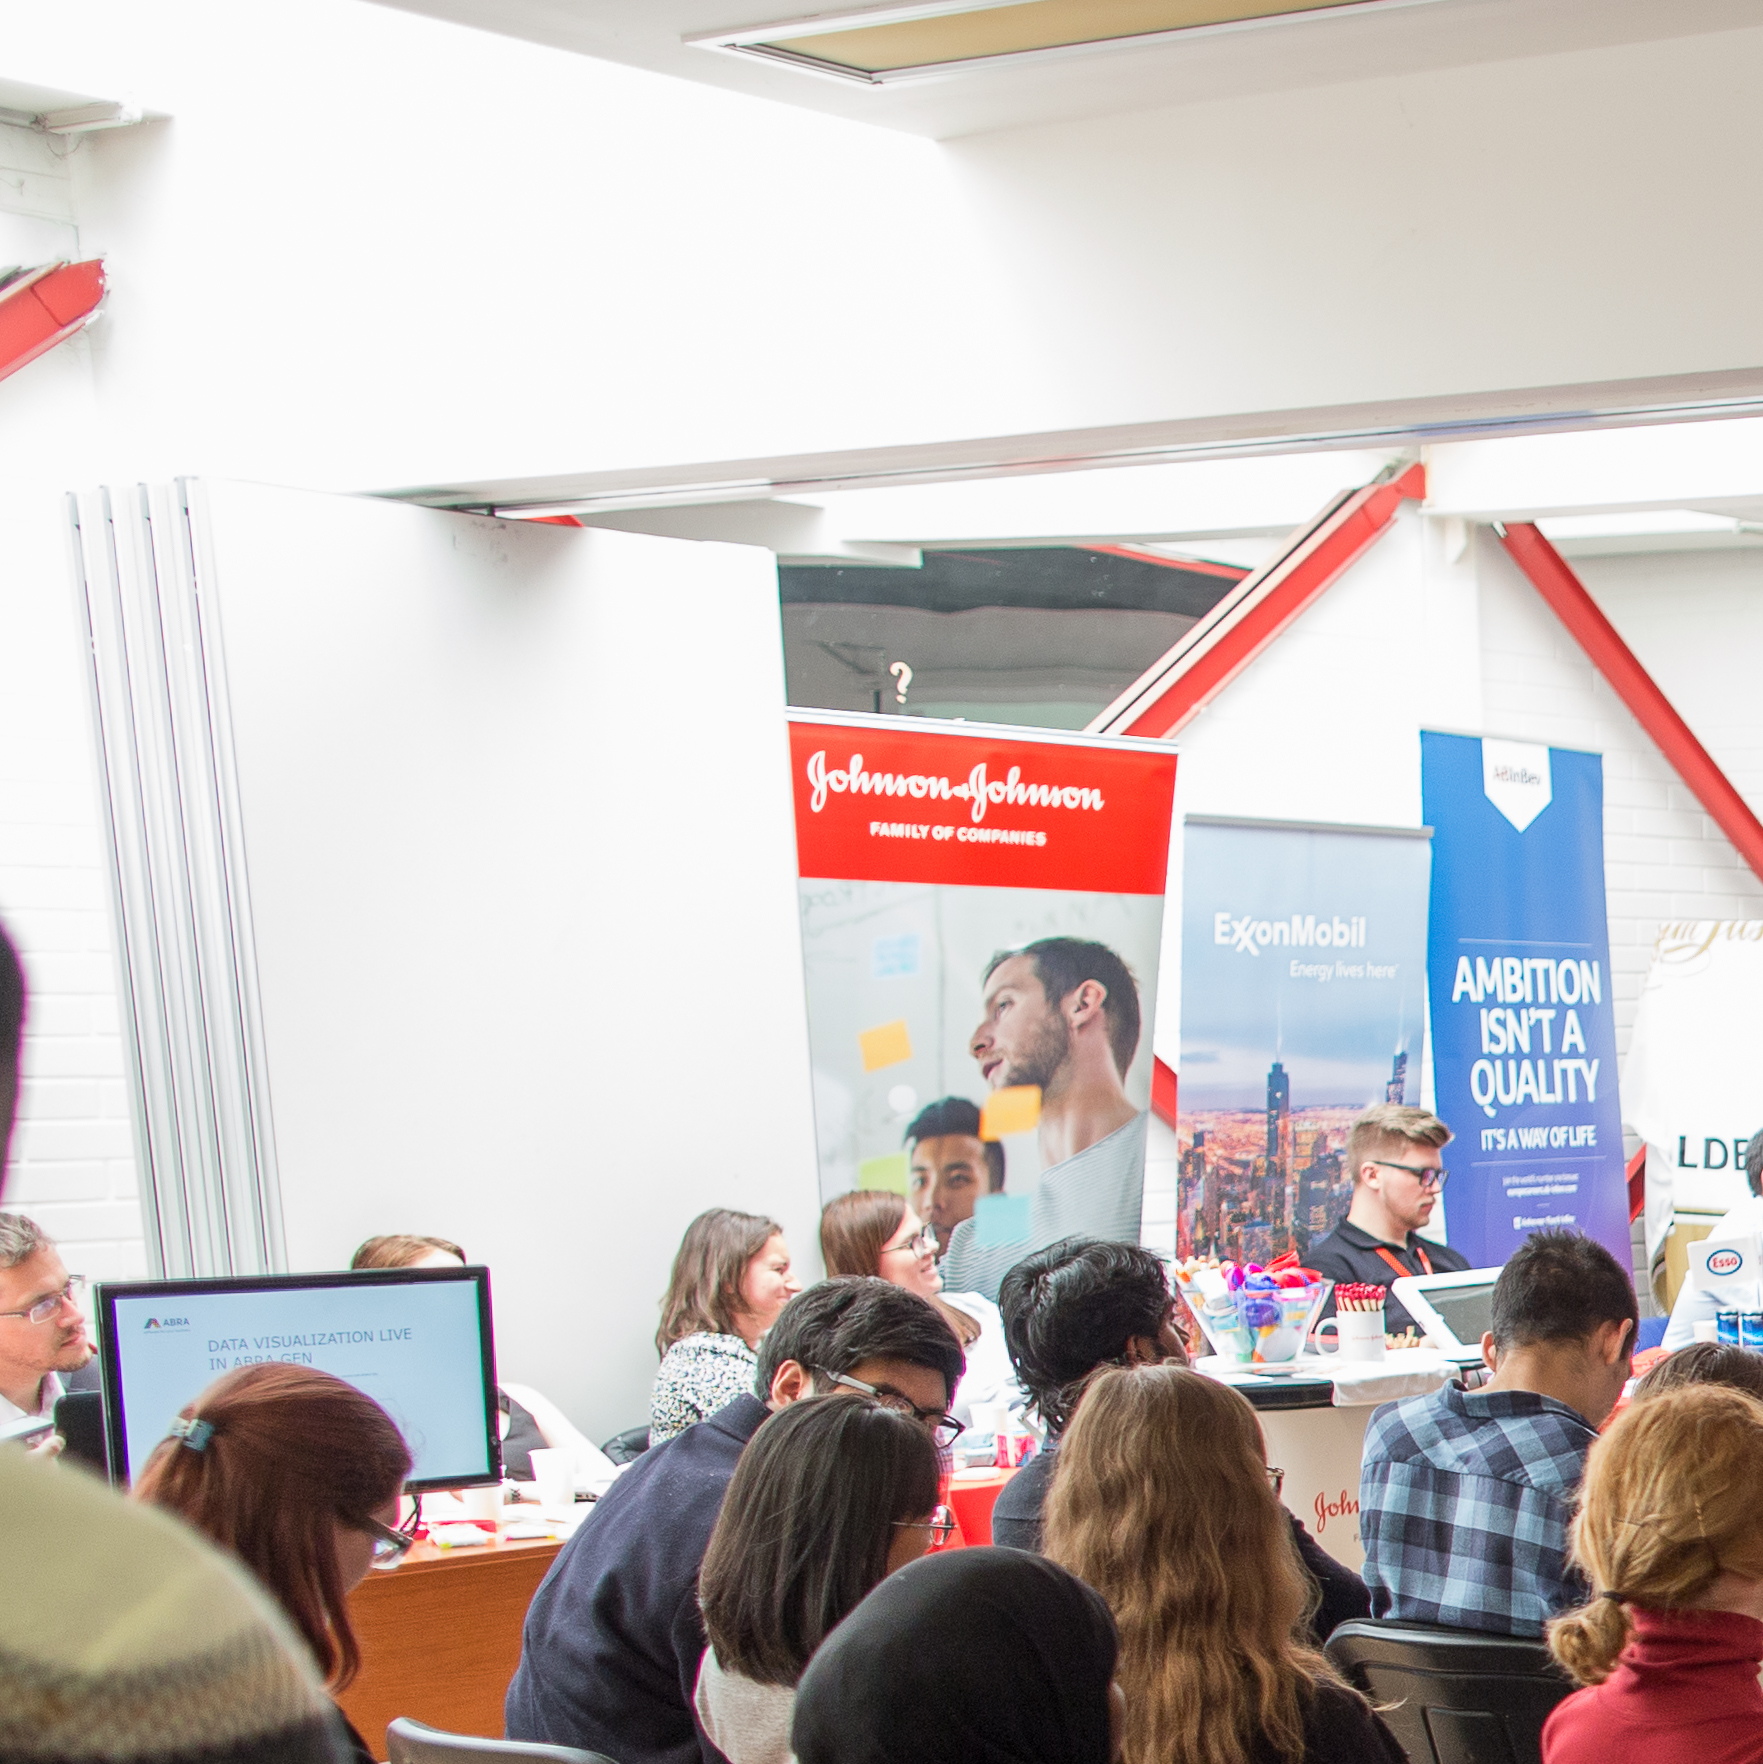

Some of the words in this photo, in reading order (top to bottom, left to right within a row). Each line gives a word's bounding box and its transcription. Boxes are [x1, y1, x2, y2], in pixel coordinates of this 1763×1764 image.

[869, 821, 929, 840] FAMILY
[931, 825, 954, 841] OF
[956, 826, 1047, 847] COMPANIES
[1214, 912, 1366, 957] ExxonMobil
[1289, 959, 1333, 982] Energy
[1335, 960, 1365, 978] lives
[1452, 955, 1602, 1006] AMBITION
[1480, 1007, 1557, 1055] ISN'T
[1561, 1009, 1587, 1054] A
[1470, 1058, 1600, 1118] QUALITY
[1481, 1128, 1506, 1151] IT'S
[1507, 1128, 1519, 1150] A
[1518, 1126, 1550, 1150] WAY
[1550, 1125, 1569, 1148] OF
[1569, 1125, 1598, 1147] LIFE
[1712, 1256, 1738, 1269] Esso
[163, 1317, 190, 1327] ABRA
[207, 1338, 249, 1353] DATA
[253, 1331, 374, 1349] VISUALIZATION
[379, 1328, 412, 1341] LIVE
[209, 1357, 227, 1370] IN
